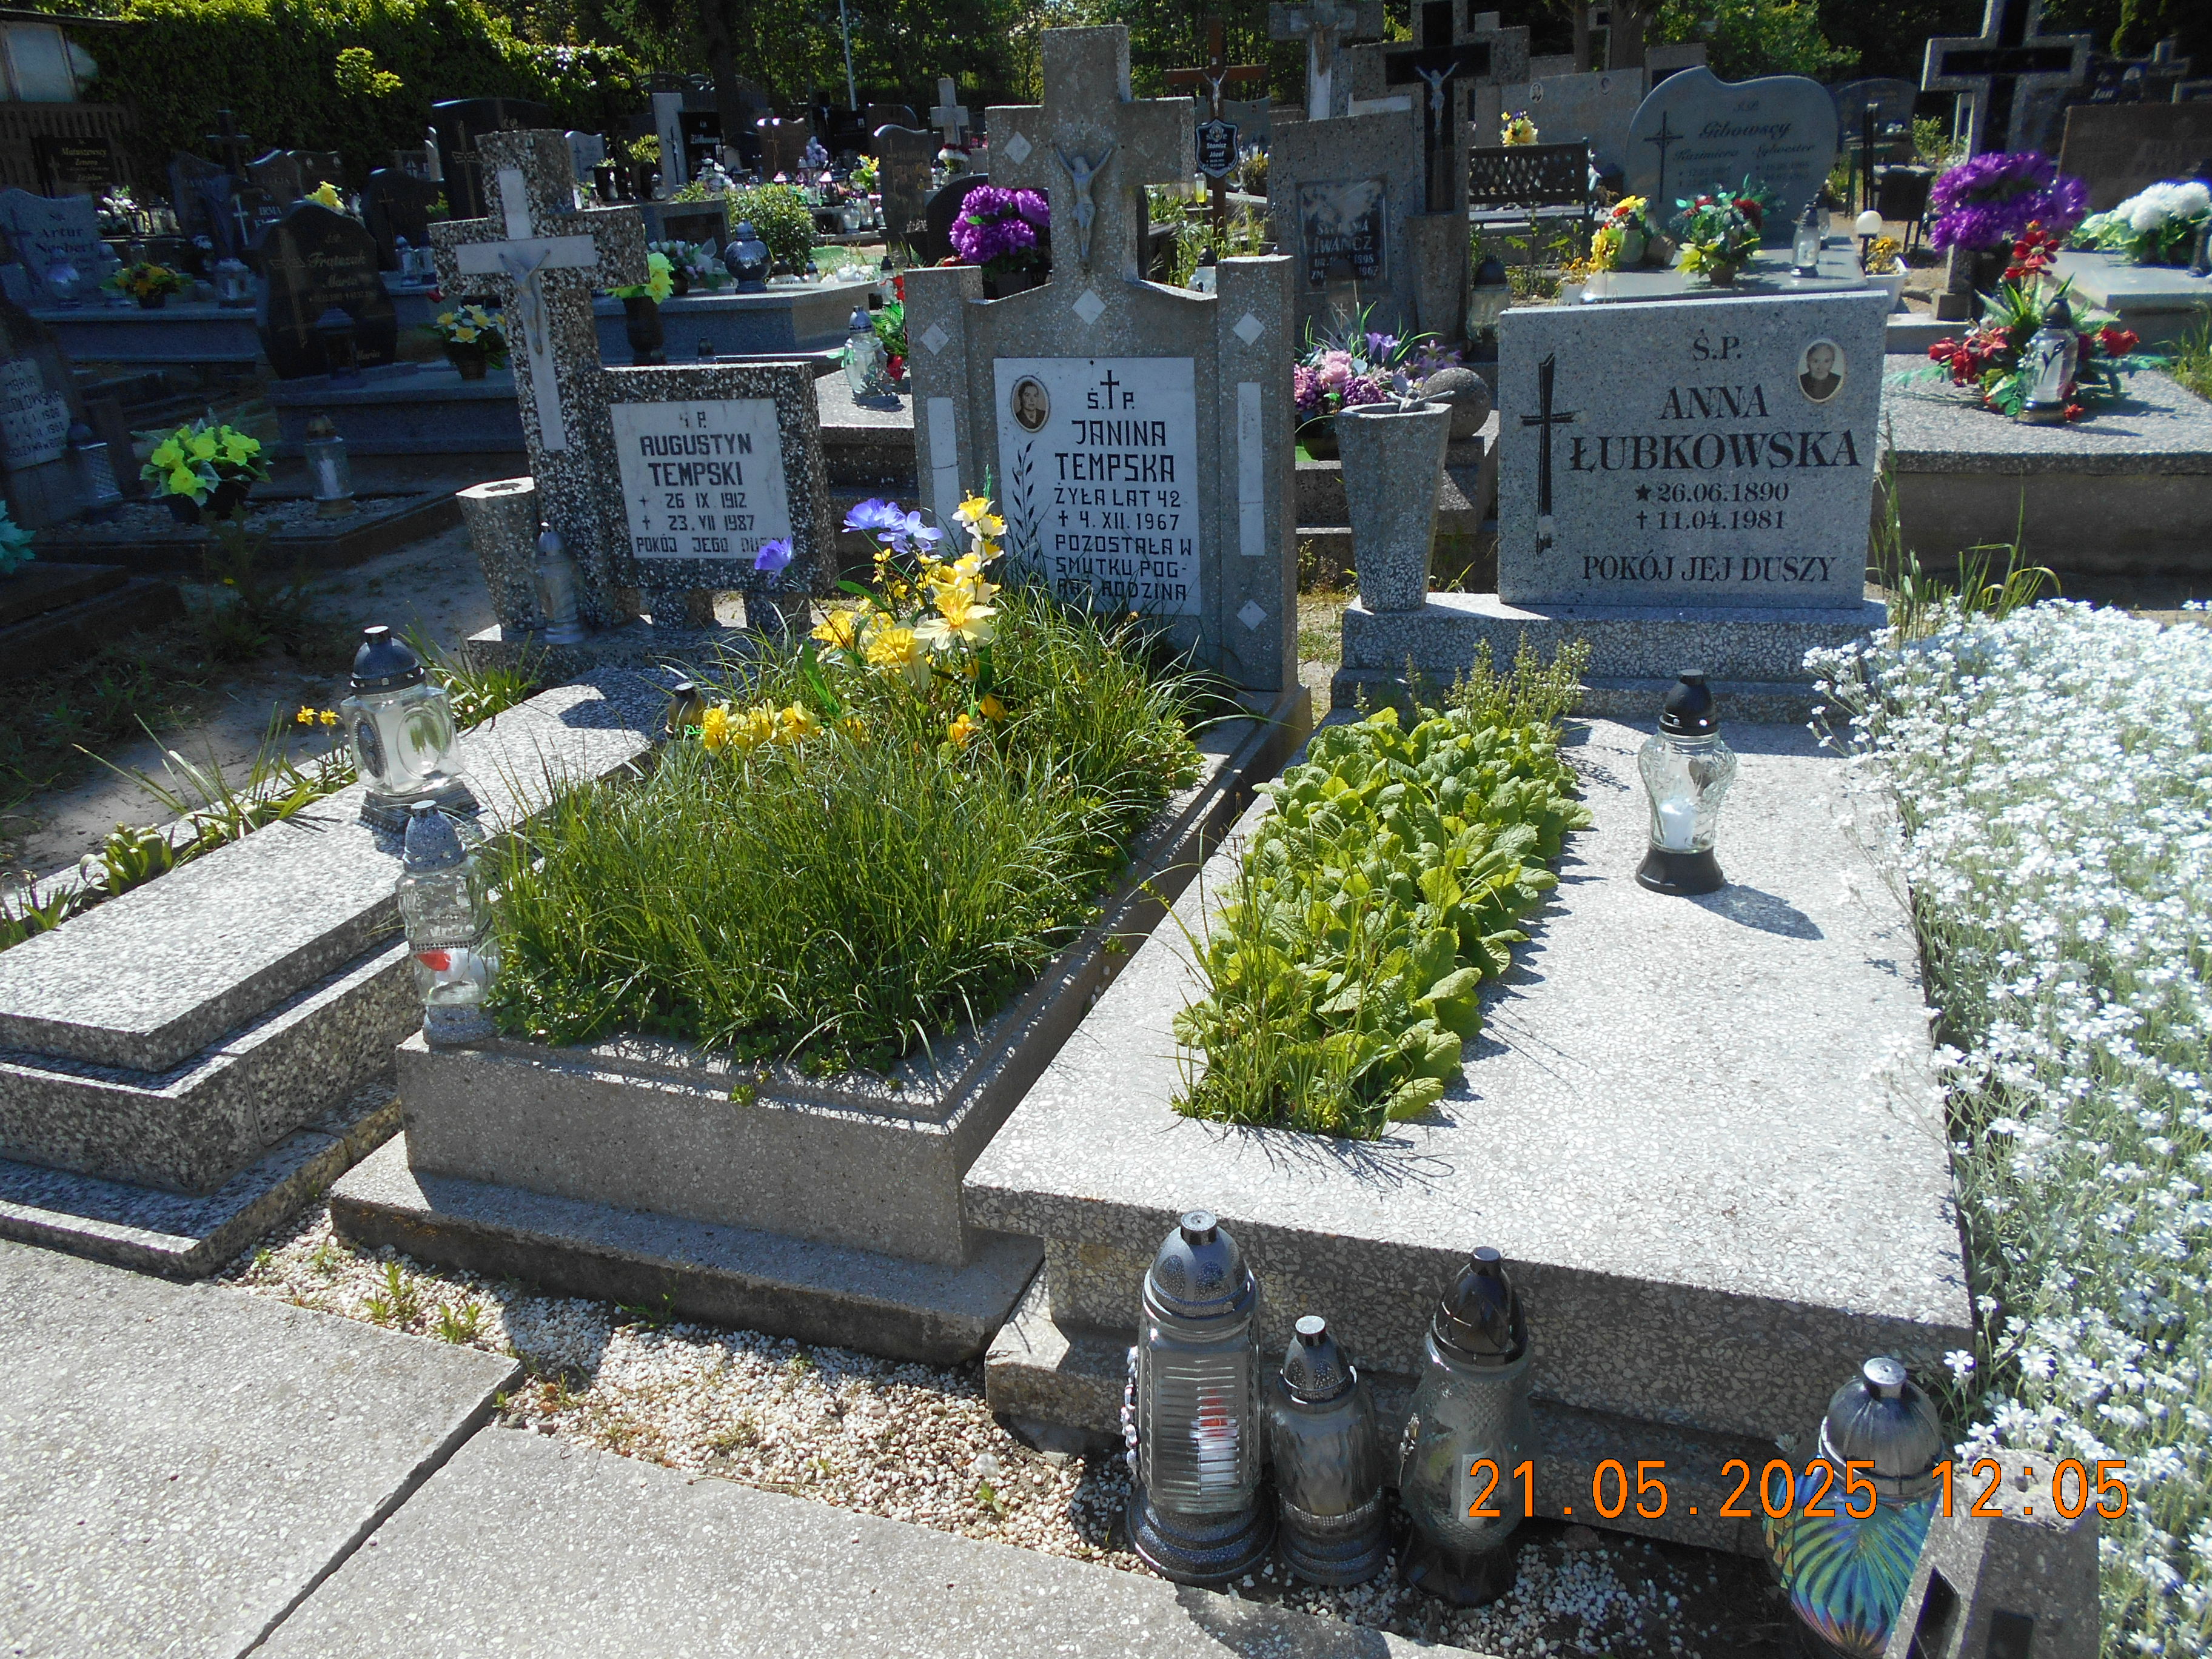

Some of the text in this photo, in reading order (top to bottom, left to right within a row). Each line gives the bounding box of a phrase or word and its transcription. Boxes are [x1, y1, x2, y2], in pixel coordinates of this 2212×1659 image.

[1699, 121, 1791, 139] Gibowscy
[1659, 383, 1769, 420] ANNA
[1071, 420, 1166, 446] JANINA
[640, 433, 752, 455] AUGUSTYN
[1569, 429, 1862, 473] ŁUBKOWSKA
[648, 461, 743, 486] TEMPSKI
[1054, 453, 1175, 483] TEMPSKA
[720, 492, 747, 508] 1912
[1054, 482, 1181, 508] ŻYŁA LAT 42
[1658, 482, 1789, 503] 26.06.1890
[724, 514, 755, 531] 1987
[1137, 514, 1179, 531] 1967
[1658, 510, 1785, 530] 11.04.1981
[636, 534, 677, 552] POKÓJ
[692, 537, 729, 552] JEGO
[1056, 534, 1191, 556] POZOSTAŁA W
[1056, 557, 1132, 575] SMUTKU
[1582, 549, 1837, 583] POKÓJ JEJ DUSZY
[1102, 580, 1187, 601] RODZINA
